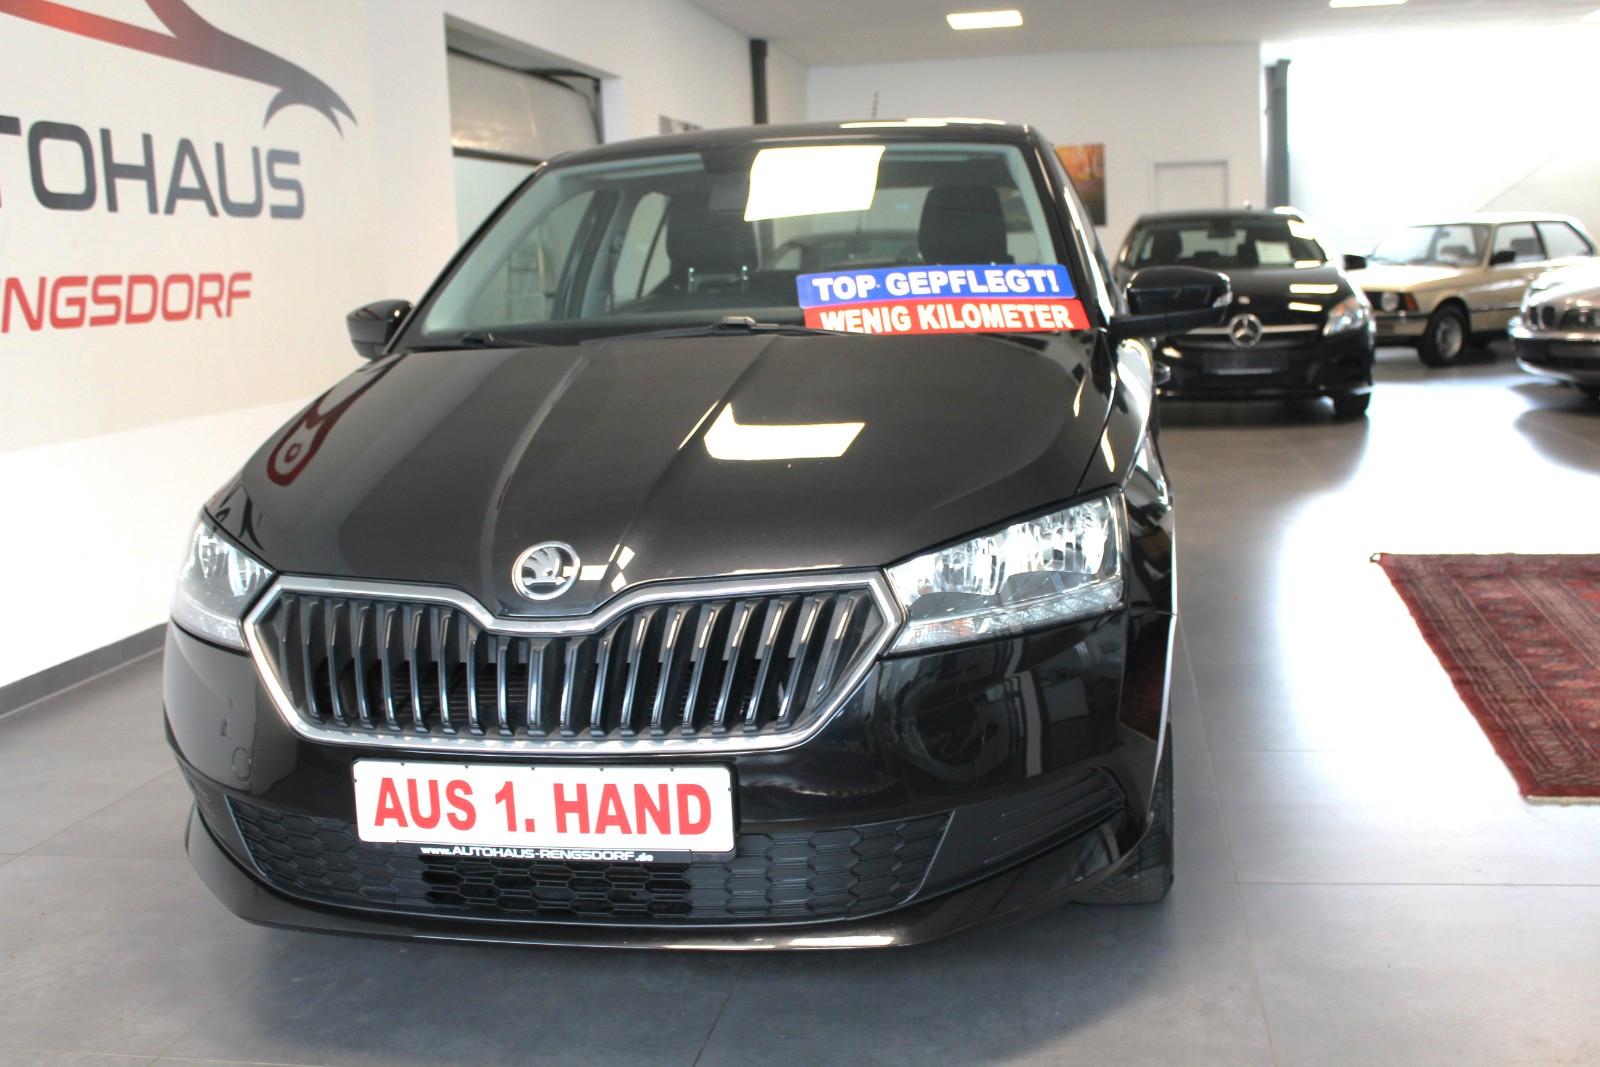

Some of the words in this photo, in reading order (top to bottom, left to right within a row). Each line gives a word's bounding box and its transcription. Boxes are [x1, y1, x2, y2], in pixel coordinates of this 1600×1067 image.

[885, 269, 1060, 296] GEPFLEGT!
[1, 272, 252, 333] NGSDORF
[820, 305, 911, 334] WENIG
[917, 302, 1074, 329] KILOMETER
[374, 777, 477, 831] AUS
[494, 781, 536, 832] 1.
[553, 782, 712, 835] HAND
[420, 846, 654, 862] www.AUTOHAUS-RENGSDORF.de
